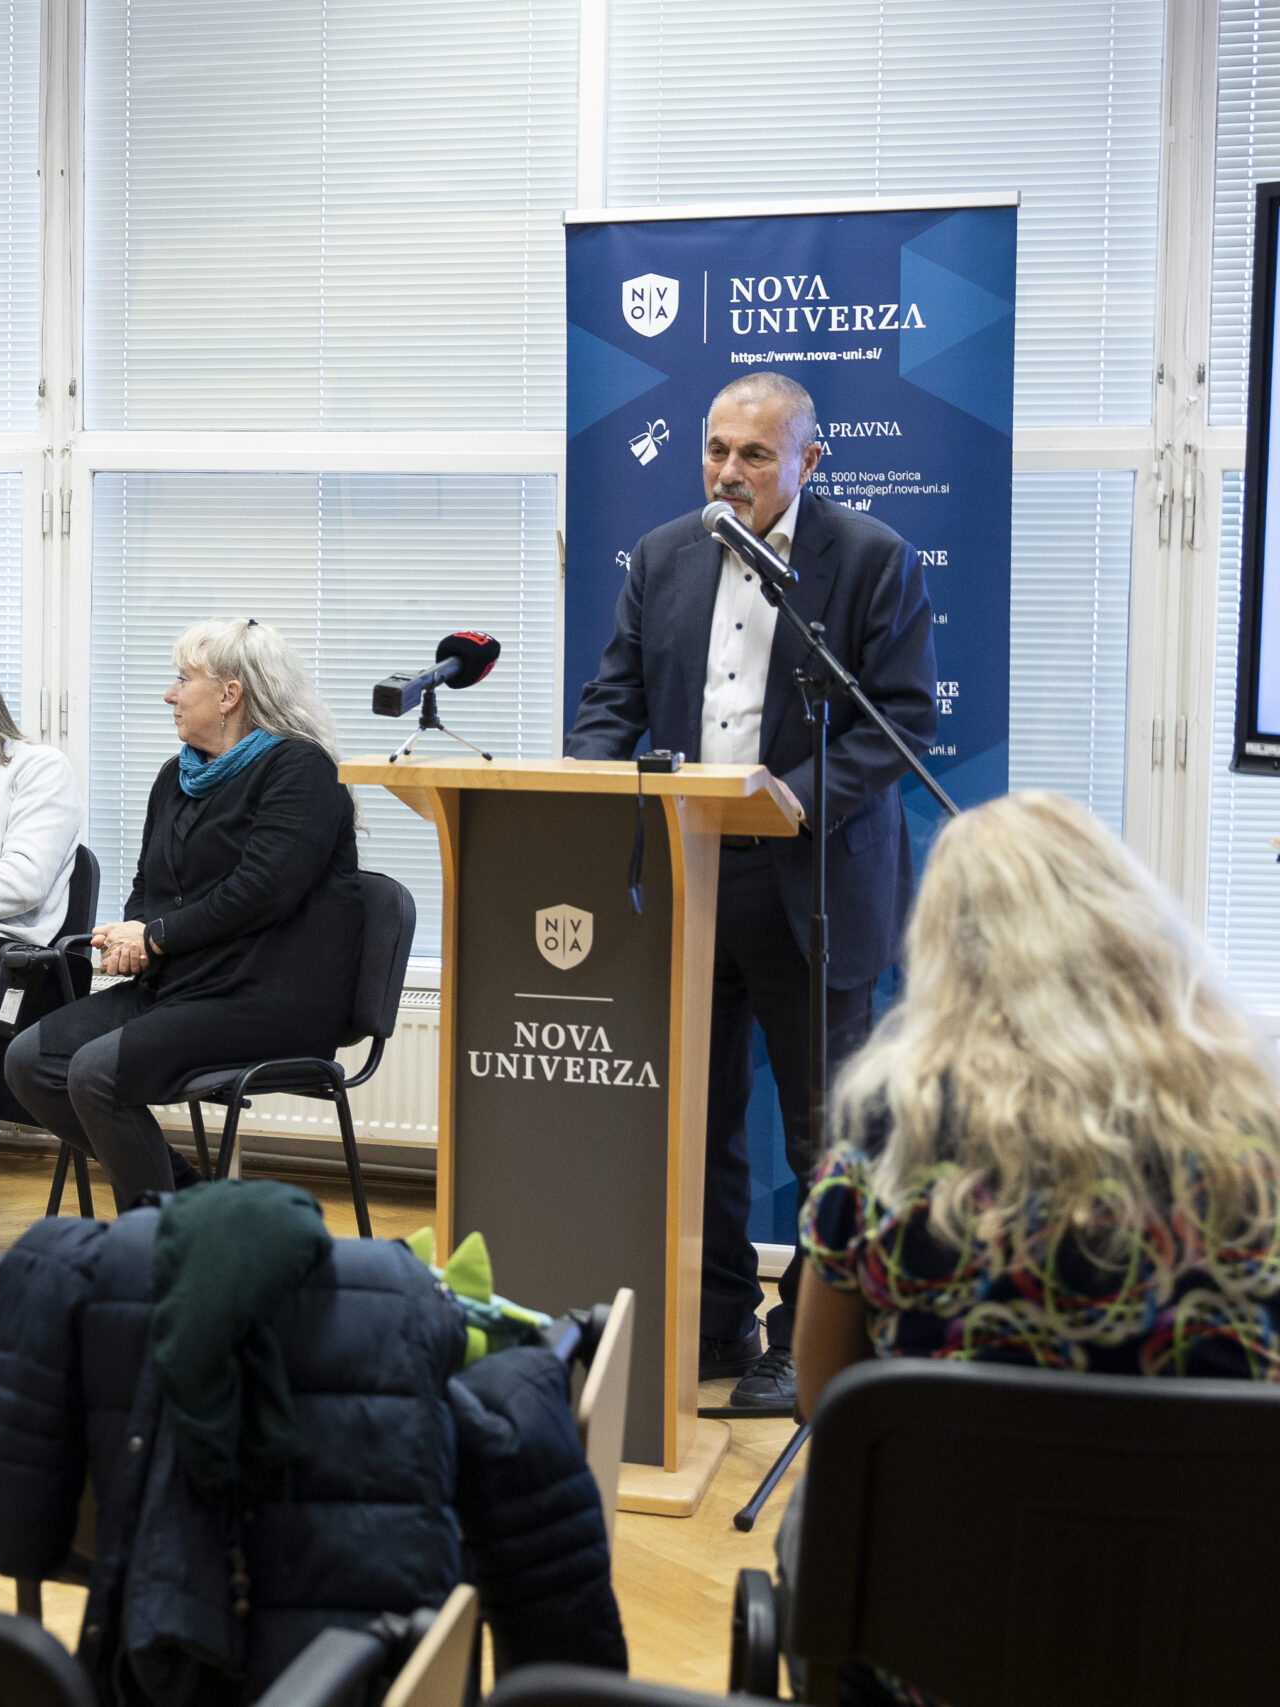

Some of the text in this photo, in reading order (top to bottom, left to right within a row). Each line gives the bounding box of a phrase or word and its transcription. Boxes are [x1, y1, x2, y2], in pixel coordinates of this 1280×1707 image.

[730, 274, 830, 302] NOVA
[730, 303, 926, 335] UNIVERZA
[730, 348, 882, 365] https://www.nova-uni.si/
[829, 421, 902, 437] PRAVNA
[831, 471, 856, 482] 5000
[858, 472, 885, 481] Nova
[888, 470, 920, 481] Gorica
[833, 485, 844, 496] E:
[846, 483, 950, 497] info@epf.nova-uni.si
[513, 1021, 613, 1053] NOVA
[468, 1050, 660, 1088] UNIVERZA
